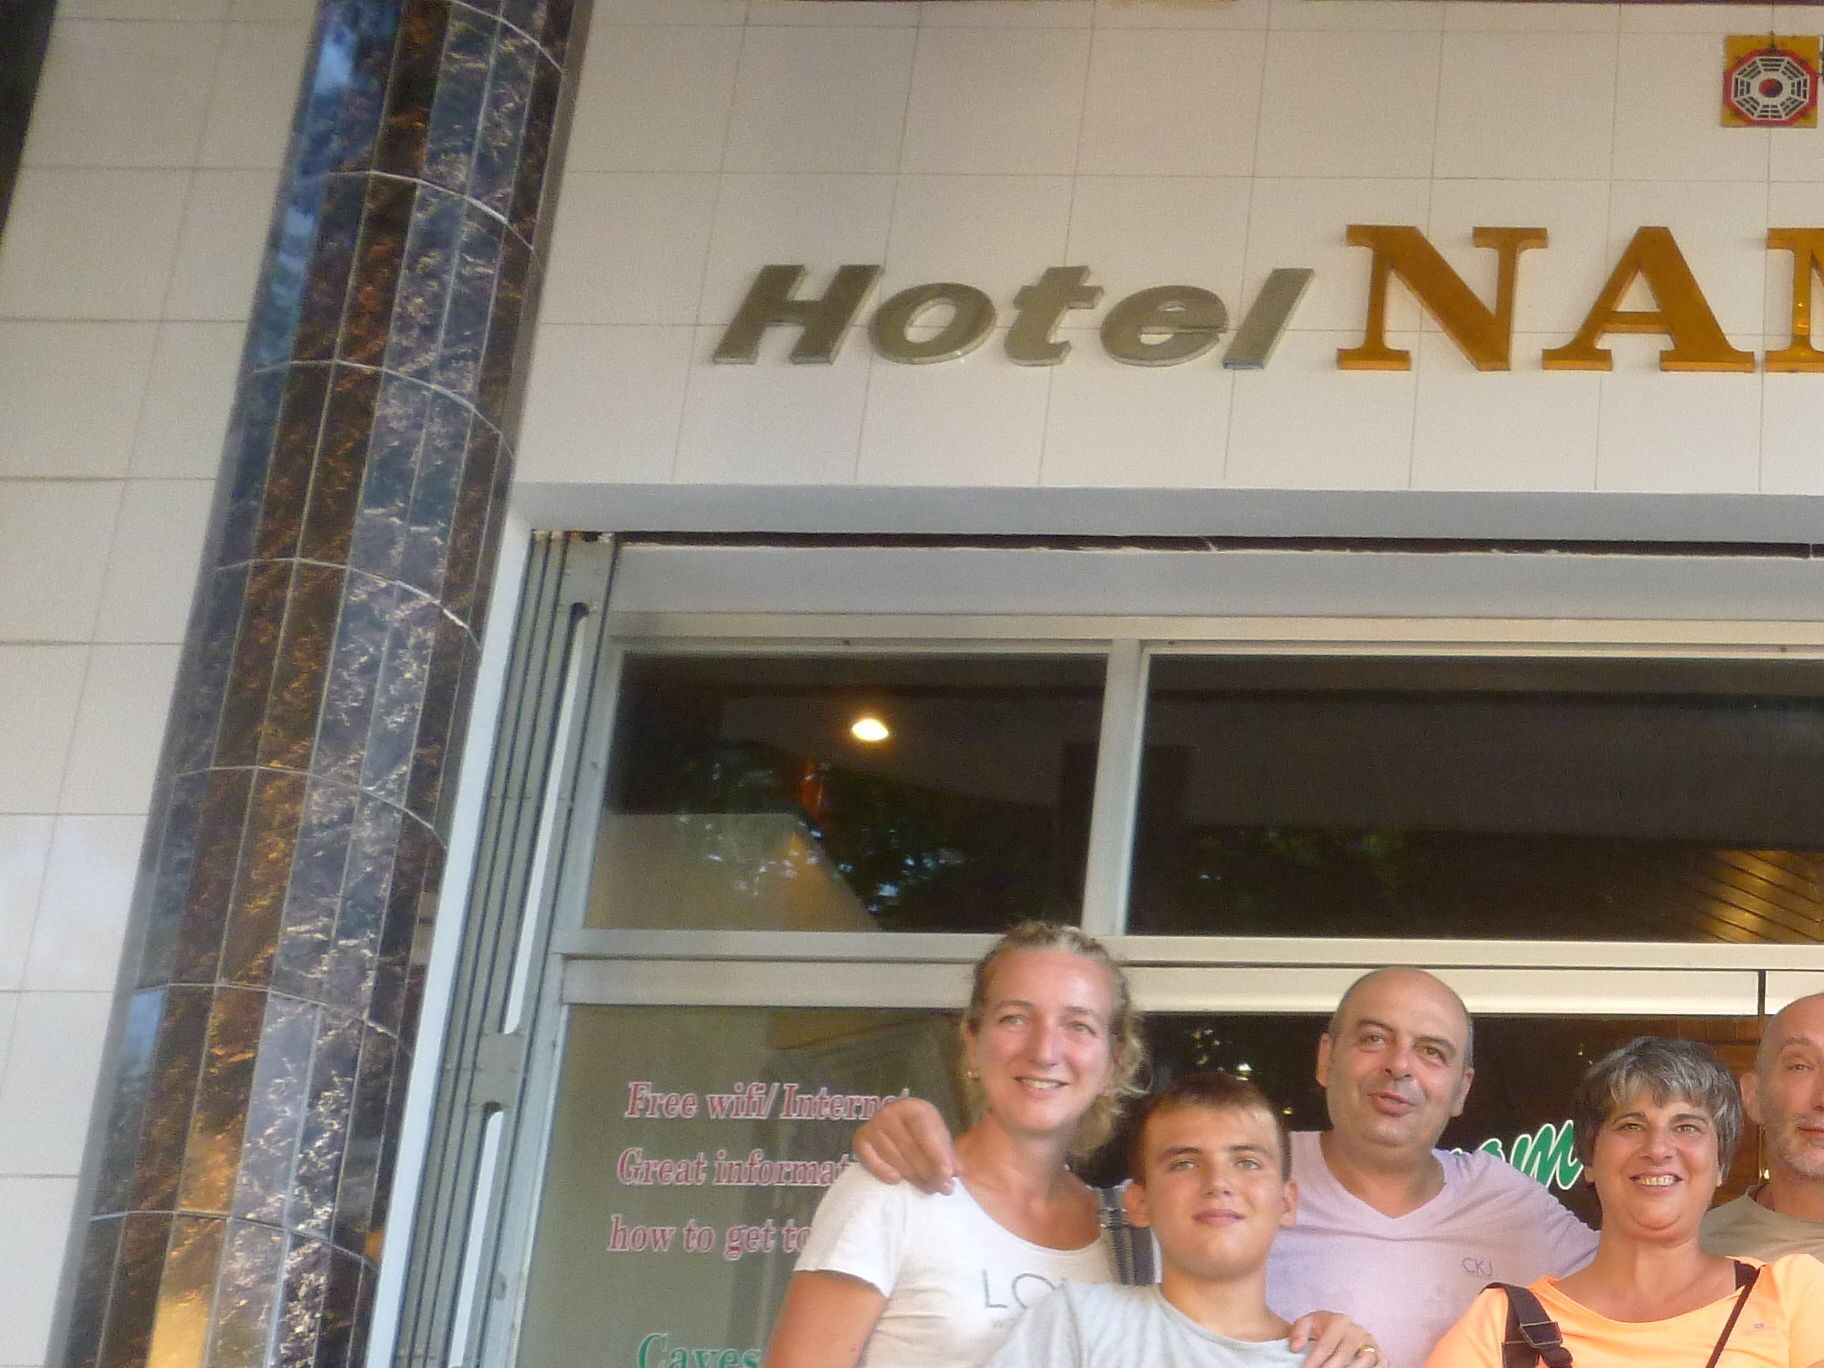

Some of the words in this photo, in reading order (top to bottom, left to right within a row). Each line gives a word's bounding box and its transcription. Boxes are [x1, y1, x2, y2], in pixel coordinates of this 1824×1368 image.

[712, 264, 1315, 370] Hotel
[624, 1081, 698, 1119] Free
[780, 1082, 911, 1121] Intern
[616, 1147, 707, 1186] Great
[713, 1149, 860, 1187] informat
[607, 1214, 676, 1253] how
[683, 1218, 717, 1253] to
[724, 1218, 777, 1261] get
